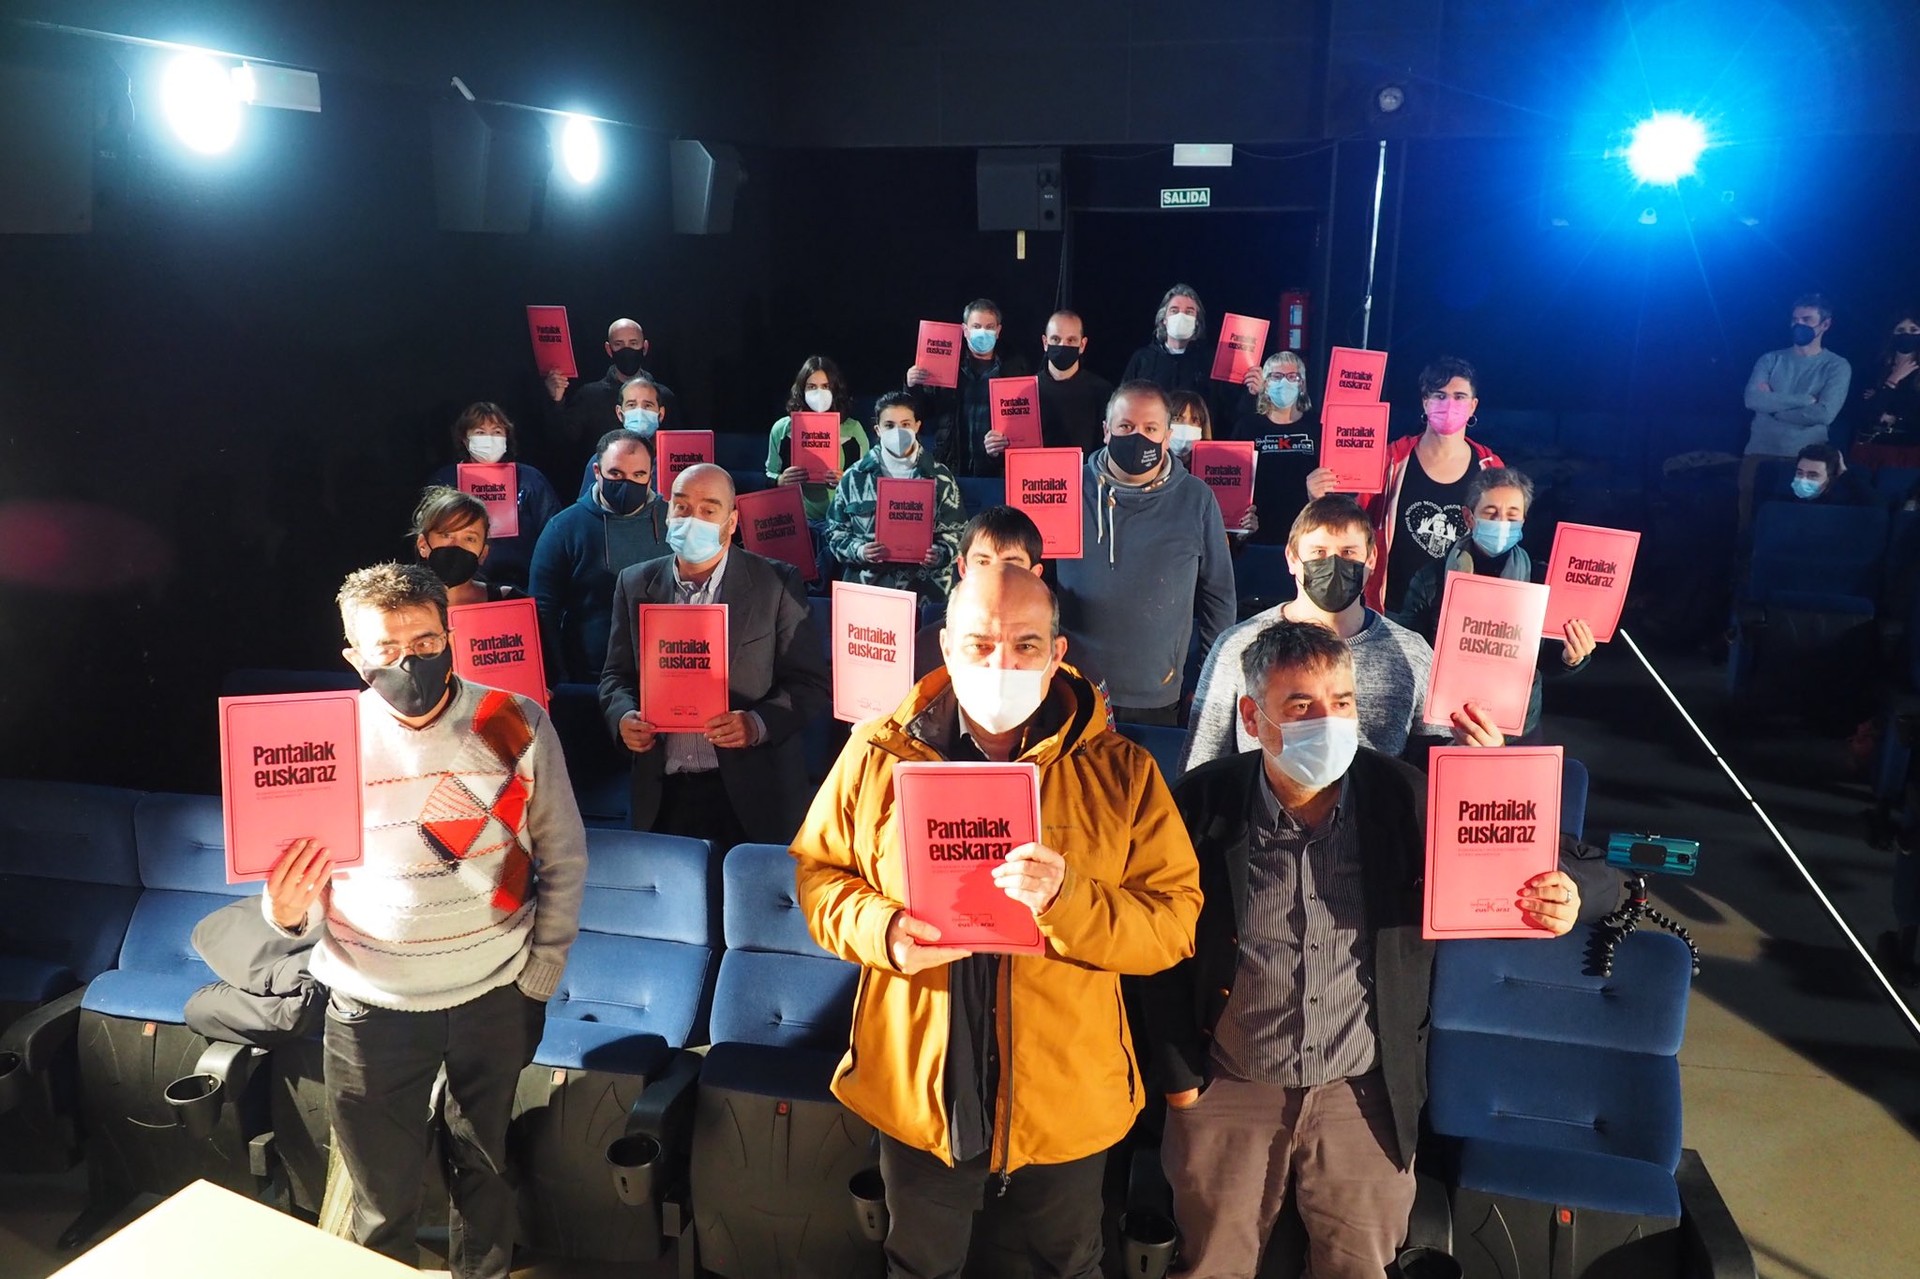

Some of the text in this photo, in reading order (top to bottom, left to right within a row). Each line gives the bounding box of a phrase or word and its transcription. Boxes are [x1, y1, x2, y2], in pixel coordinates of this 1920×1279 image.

[1163, 190, 1207, 204] SALIDA
[926, 339, 952, 348] Pantailak
[1230, 333, 1257, 345] Pantailak
[925, 347, 952, 355] euskaraz
[1228, 342, 1255, 352] euskaraz
[1340, 369, 1373, 381] Pantailak
[1338, 380, 1372, 390] euskaraz
[1000, 397, 1030, 408] Pantailak
[1000, 407, 1030, 416] euskaraz
[801, 430, 830, 440] Pantailak
[1336, 426, 1375, 437] Pantailak
[801, 440, 830, 448] euskaraz
[1336, 438, 1374, 448] euskaraz
[670, 453, 704, 463] Pantailak
[1205, 465, 1242, 476] Pantailak
[470, 483, 506, 493] Pantailak
[1022, 478, 1068, 491] Pantailak
[1022, 491, 1068, 504] euskaraz
[889, 500, 924, 511] Pantailak
[754, 513, 794, 530] Pantailak
[888, 510, 923, 521] euskaraz
[756, 525, 796, 542] euskaraz
[1568, 556, 1617, 574] Pantailak
[1565, 571, 1615, 588] euskaraz
[847, 623, 896, 646] Pantailak
[1462, 616, 1522, 641] Pantailak
[470, 633, 524, 651] Pantailak
[658, 639, 711, 654] Pantailak
[1459, 637, 1520, 659] euskaraz
[472, 650, 526, 666] euskaraz
[847, 641, 896, 663] euskaraz
[658, 655, 711, 670] euskaraz
[252, 741, 336, 766] Pantailak
[254, 765, 337, 788] euskaraz
[1458, 799, 1537, 821] Pantailak
[927, 817, 1012, 839] Pantailak
[1457, 823, 1536, 844] euskaraz
